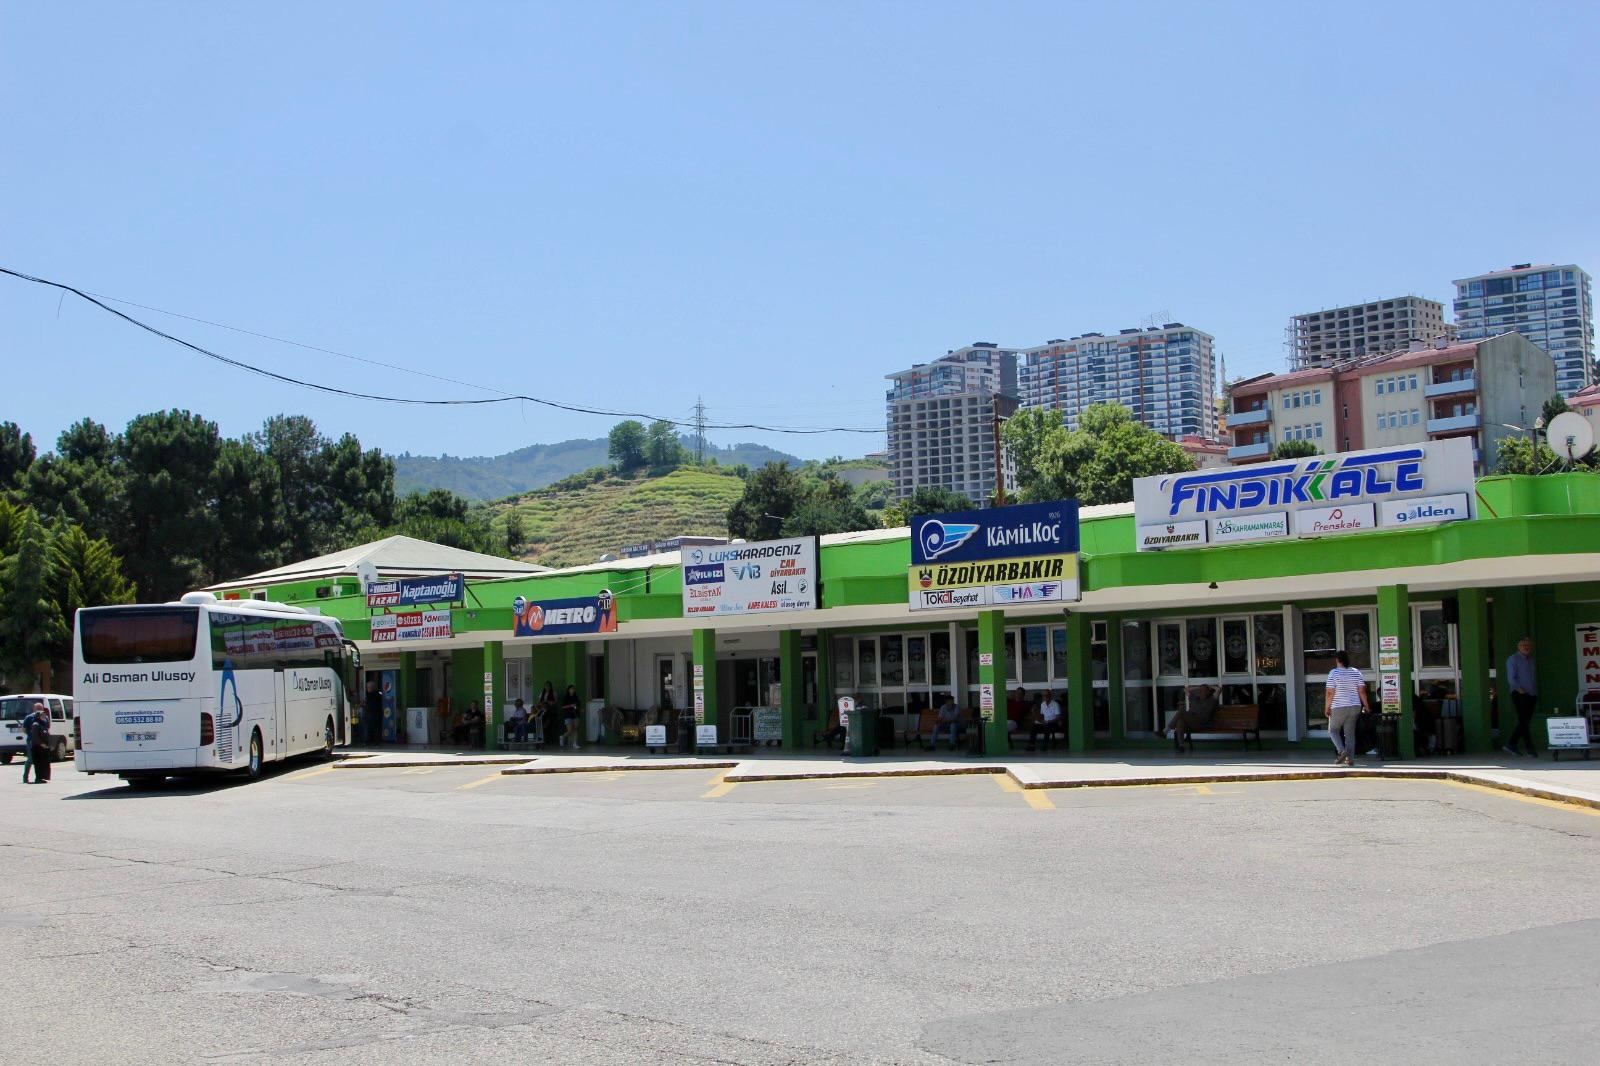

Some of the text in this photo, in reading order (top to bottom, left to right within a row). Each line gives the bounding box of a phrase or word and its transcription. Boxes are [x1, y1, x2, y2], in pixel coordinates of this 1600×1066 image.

[1313, 519, 1361, 532] Prenskale
[401, 581, 457, 600] Kaptanoğlu
[543, 605, 597, 626] METRO
[83, 671, 196, 684] Ali Osman Ulusoy
